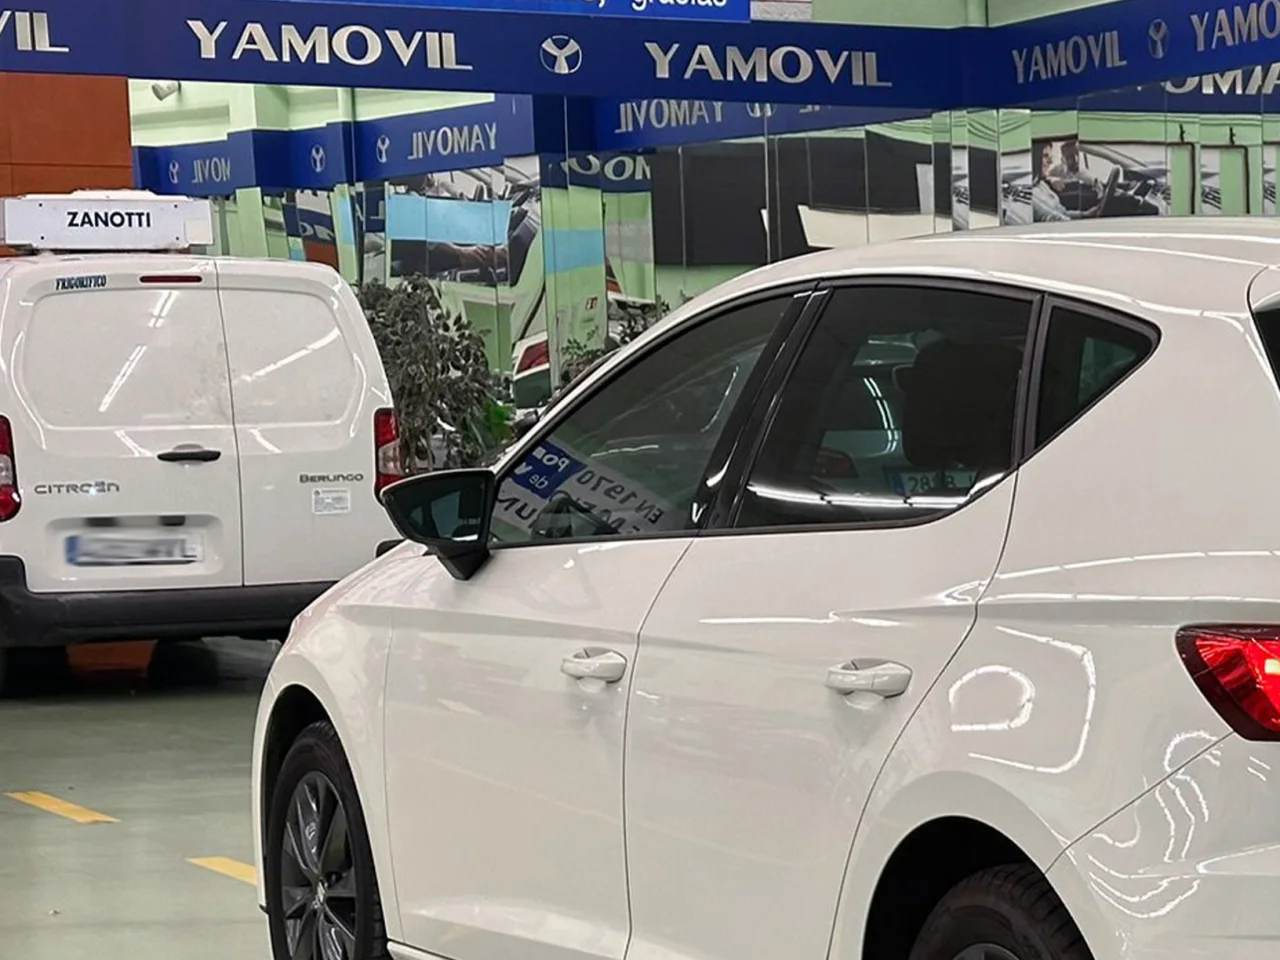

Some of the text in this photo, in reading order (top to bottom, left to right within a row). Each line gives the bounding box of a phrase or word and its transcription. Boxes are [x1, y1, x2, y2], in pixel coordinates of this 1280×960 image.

[186, 19, 473, 71] YAMOVIL
[644, 41, 893, 88] YAMOVIL
[1011, 30, 1128, 84] YAMOVIL
[66, 211, 151, 228] ZANOTTI
